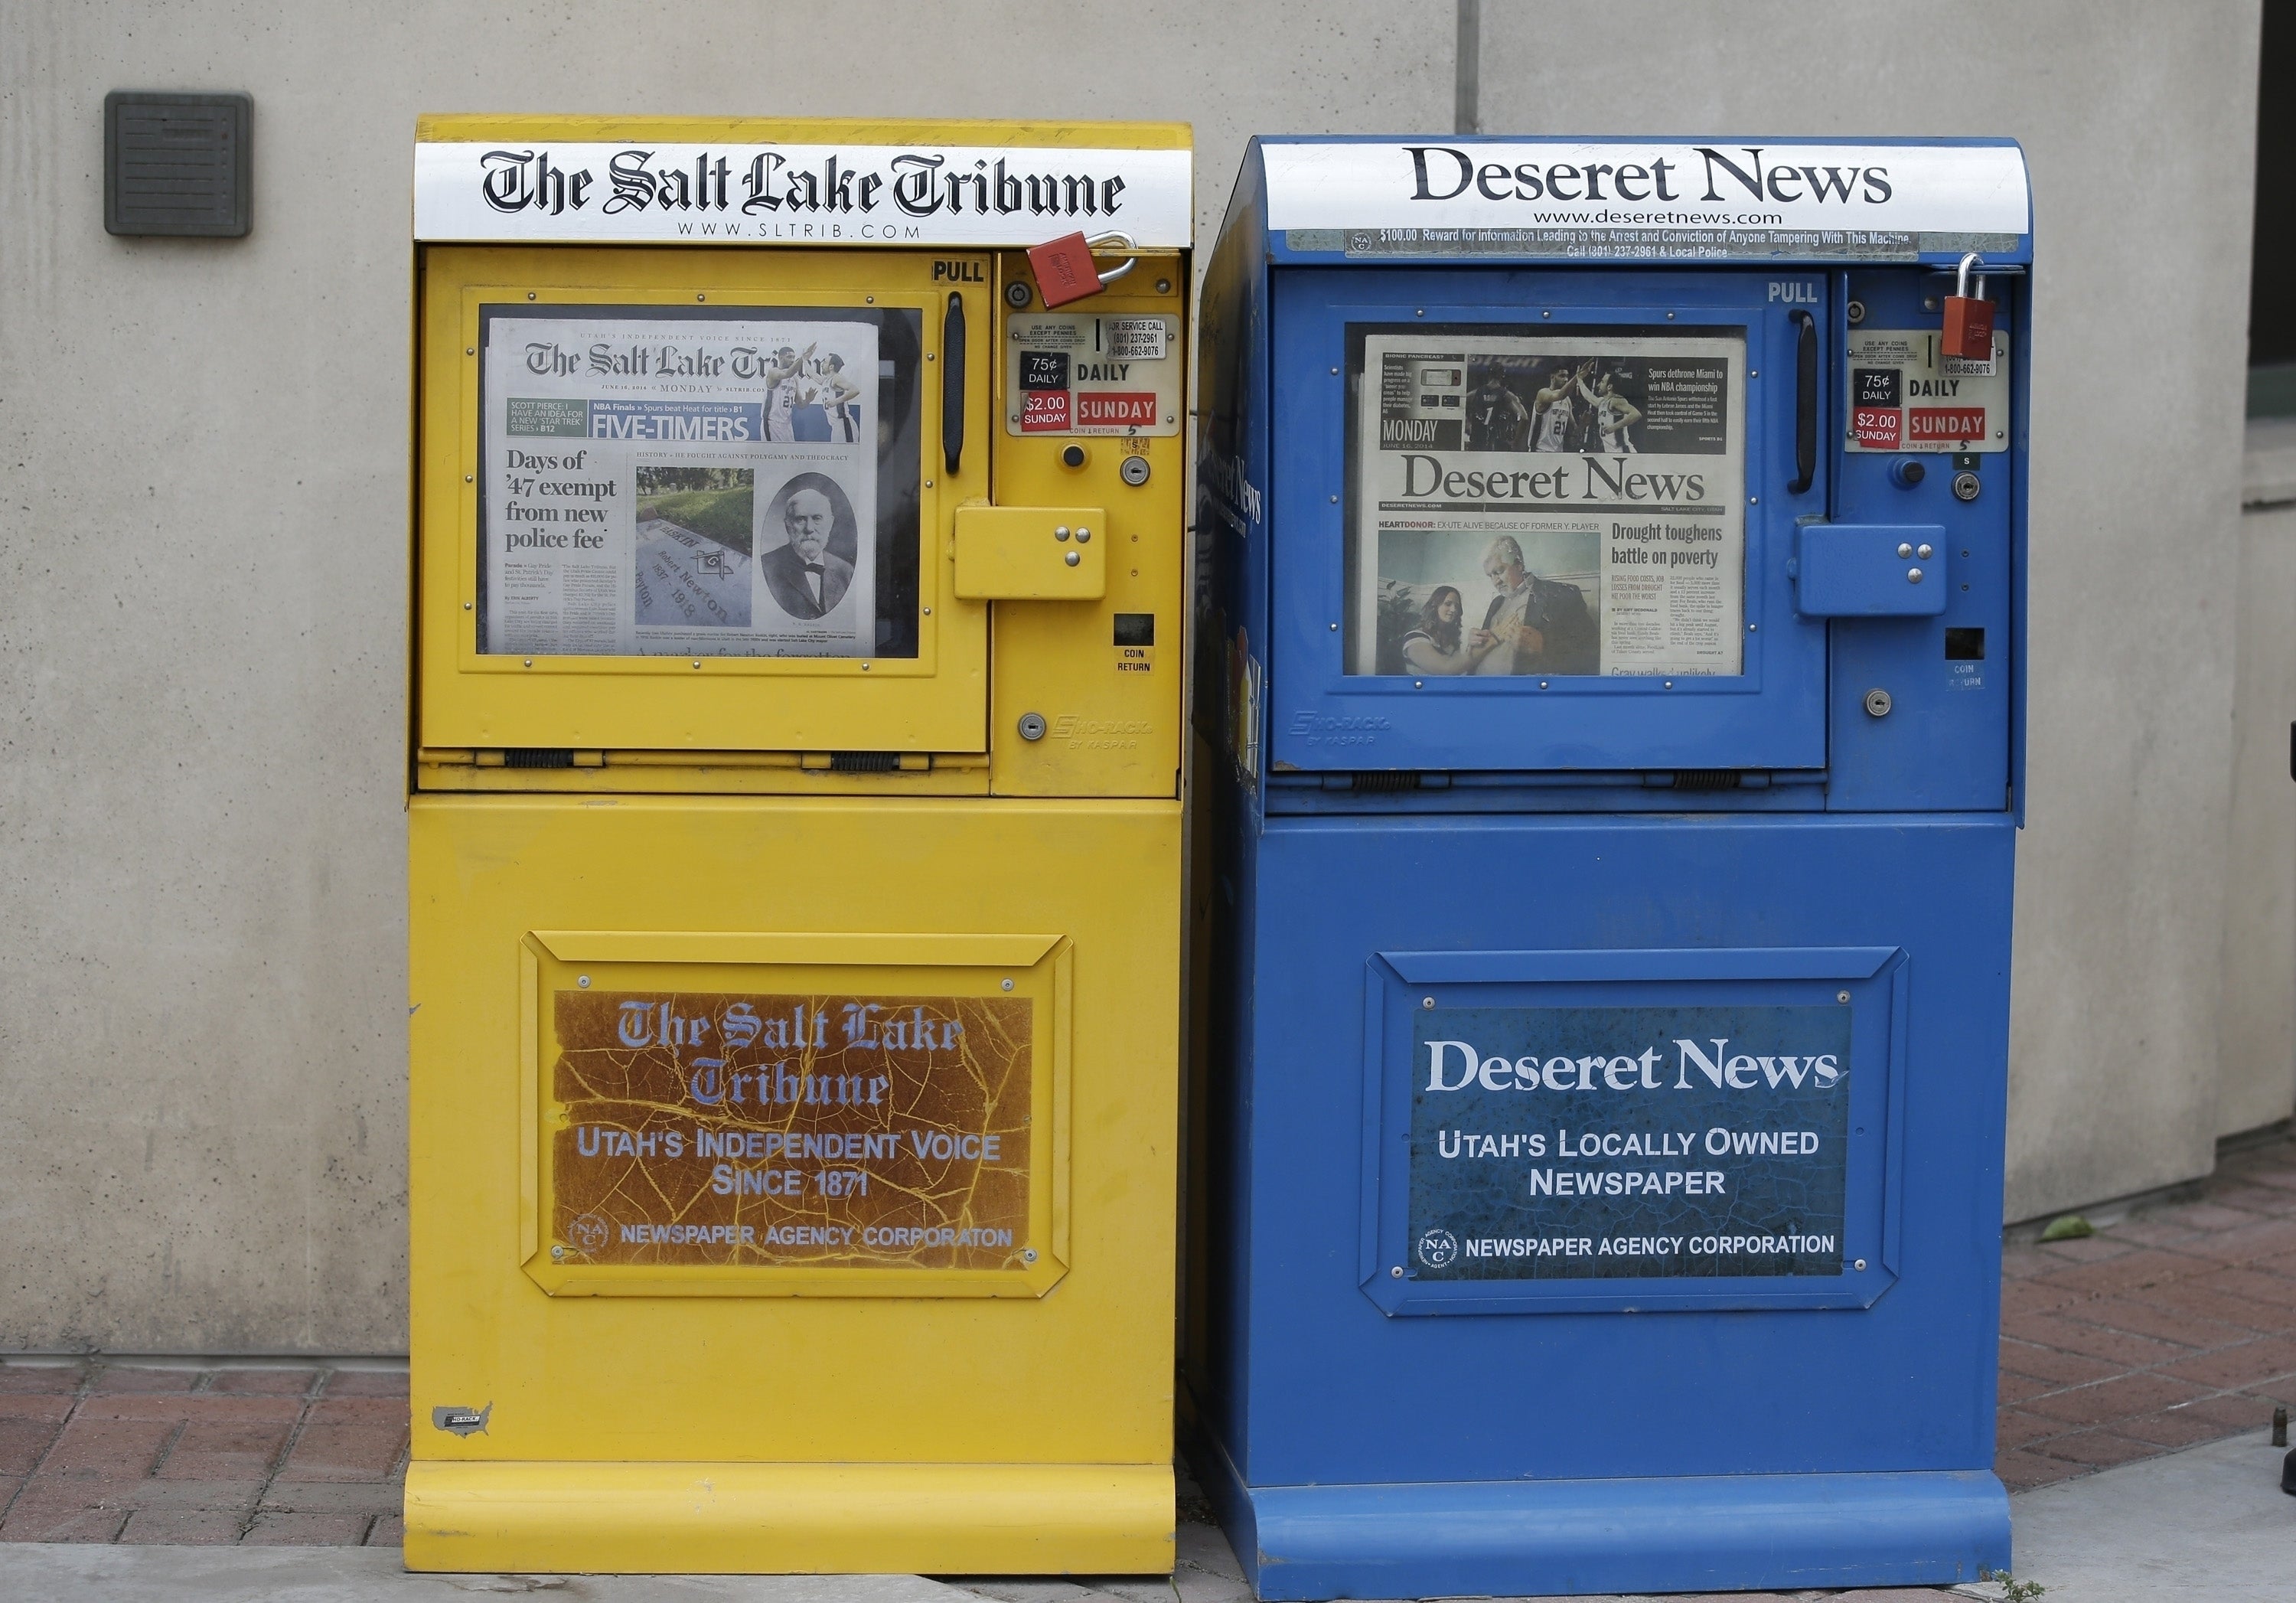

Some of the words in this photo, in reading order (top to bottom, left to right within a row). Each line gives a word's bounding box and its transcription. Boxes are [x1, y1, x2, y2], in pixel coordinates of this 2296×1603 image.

[480, 149, 594, 216] The
[602, 149, 732, 216] Salt
[741, 151, 883, 217] Lake
[890, 153, 1127, 218] Tribune
[1401, 147, 1680, 201] Deseret
[1692, 148, 1893, 204] News
[1534, 209, 1782, 225] www.deseretnews.com
[678, 222, 920, 239] WWW.SLTRIB.COM
[1380, 229, 1417, 243] $100.00
[1423, 229, 1459, 242] Reward
[1462, 229, 1476, 242] for
[1478, 229, 1534, 242] Information
[1537, 229, 1576, 244] Leading
[1578, 230, 1587, 242] to
[1590, 229, 1606, 242] the
[1609, 230, 1639, 243] Arrest
[1641, 230, 1659, 243] and
[1662, 230, 1714, 243] Conviction
[1716, 230, 1727, 243] of
[1729, 230, 1766, 246] Anyone
[1768, 230, 1819, 246] Tampering
[1821, 231, 1843, 243] With
[1846, 231, 1867, 244] This
[1869, 231, 1911, 245] Machine.
[1567, 244, 1585, 257] Call
[1614, 245, 1656, 257] 237-2961
[1659, 246, 1667, 257] &
[1669, 246, 1696, 257] Local
[1698, 246, 1727, 258] Police
[933, 260, 984, 282] PULL
[1768, 282, 1818, 303] PULL
[1121, 322, 1146, 331] SERVICE
[1148, 322, 1163, 331] CALL
[1114, 332, 1129, 344] (801)
[1130, 333, 1158, 344] 237-2961
[1112, 346, 1159, 356] 1-800-662-9076
[525, 342, 582, 377] The
[585, 343, 650, 378] Salt
[655, 344, 726, 379] Lake
[1032, 357, 1058, 371] 75¢
[1945, 364, 1990, 374] 1-800-662-9076
[1029, 374, 1058, 384] DAILY
[1077, 364, 1130, 381] DAILY
[1648, 367, 1667, 380] Spurs
[1667, 368, 1695, 378] dethrone
[1696, 368, 1715, 379] Miami
[1716, 369, 1724, 379] to
[1864, 374, 1890, 387] 75¢
[660, 384, 713, 393] MONDAY
[1648, 382, 1660, 392] win
[1661, 381, 1675, 392] NBA
[1675, 382, 1718, 394] championship
[1862, 390, 1891, 400] DAILY
[1909, 379, 1960, 397] DAILY
[511, 402, 535, 410] SCOTT
[537, 402, 564, 411] PIERCE:
[593, 403, 611, 411] NBA
[612, 403, 635, 412] Finals
[644, 404, 664, 413] Spurs
[664, 404, 681, 413] beat
[713, 405, 728, 413] title
[1026, 397, 1065, 412] $2.00
[1080, 400, 1154, 419] SUNDAY
[1024, 413, 1066, 424] SUNDAY
[1857, 412, 1896, 429] $2.00
[1911, 416, 1983, 433] SUNDAY
[540, 425, 555, 433] B12
[592, 413, 750, 442] FIVE-TIMERS
[1383, 419, 1439, 442] MONDAY
[1855, 429, 1896, 442] SUNDAY
[506, 449, 558, 475] Days
[563, 449, 588, 470] of
[1401, 454, 1570, 498] Deseret
[1581, 456, 1705, 501] News
[505, 474, 536, 498] '47
[539, 479, 618, 502] exempt
[1234, 455, 1261, 525] News
[505, 500, 559, 522] from
[564, 508, 609, 523] new
[1437, 521, 1462, 529] EX-UTE
[1463, 521, 1483, 530] ALIVE
[1485, 521, 1518, 531] BECAUSE
[1519, 522, 1530, 531] OF
[1531, 522, 1562, 531] FORMER
[1571, 523, 1600, 531] PLAYER
[1611, 522, 1662, 544] Drought
[1665, 524, 1723, 544] toughens
[505, 527, 568, 553] police
[572, 527, 604, 549] fee
[1611, 547, 1649, 565] battle
[1652, 550, 1667, 565] on
[1671, 549, 1719, 570] poverty
[1124, 649, 1144, 658] COIN
[1117, 662, 1150, 672] RETURN
[1954, 664, 1975, 674] COIN
[1949, 677, 1981, 687] RURN
[618, 1000, 711, 1056] The
[722, 1001, 829, 1050] Salt
[841, 1002, 964, 1051] Lake
[1424, 1040, 1663, 1092] Deseret
[1672, 1037, 1839, 1090] News
[690, 1056, 889, 1106] Tribune
[577, 1127, 684, 1157] UTAH'S
[696, 1128, 902, 1159] INDEPENDENT
[911, 1130, 1000, 1161] VOICE
[1438, 1129, 1547, 1159] UTAH'S
[1559, 1128, 1697, 1157] LOCALLY
[1704, 1127, 1820, 1156] OWNED
[712, 1164, 802, 1196] SINCE
[814, 1170, 867, 1197] 1871
[1530, 1168, 1727, 1196] NEWSPAPER
[621, 1224, 755, 1245] NEWSPAPER
[765, 1226, 854, 1246] AGENCY
[1465, 1237, 1593, 1257] NEWSPAPER
[1597, 1236, 1684, 1256] AGENCY
[1688, 1234, 1835, 1255] CORPORATION
